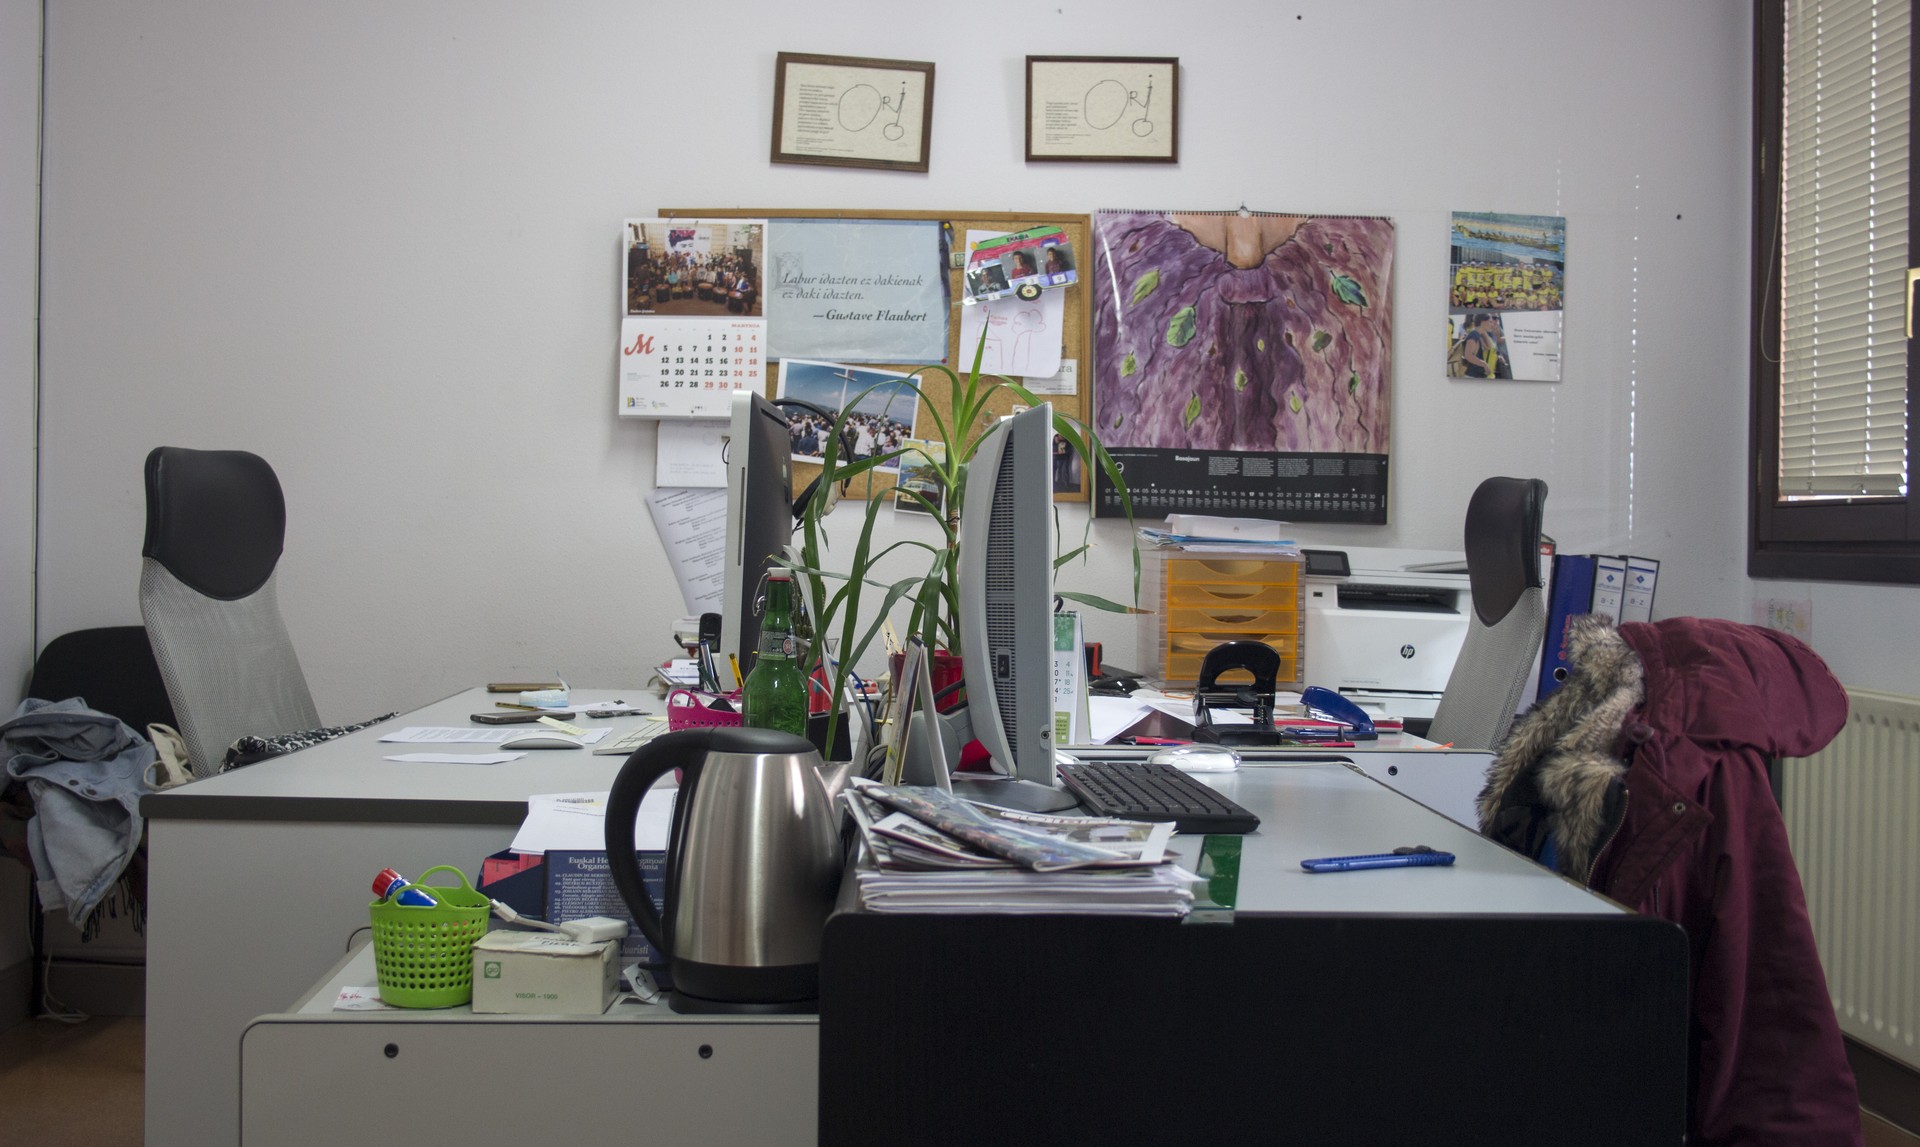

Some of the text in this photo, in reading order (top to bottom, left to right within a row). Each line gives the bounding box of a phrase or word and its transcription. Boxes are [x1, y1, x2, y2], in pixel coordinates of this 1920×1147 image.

[782, 273, 923, 287] Labur idazten ez dakienak
[782, 288, 864, 300] ez daki idazten.
[876, 310, 927, 322] Flaubert
[707, 333, 712, 341] 1
[721, 333, 727, 341] 2
[751, 334, 757, 342] 4
[663, 344, 758, 354] 5 6 7 8 9 10 11
[661, 356, 758, 366] 12 13 14 15 16 17 18
[660, 368, 758, 378] 19 20 21 22 23 24 25
[659, 380, 743, 389] 26 27 28 29 30 31
[1401, 645, 1414, 659] hp
[1064, 678, 1071, 686] 18
[1063, 687, 1071, 695] 25
